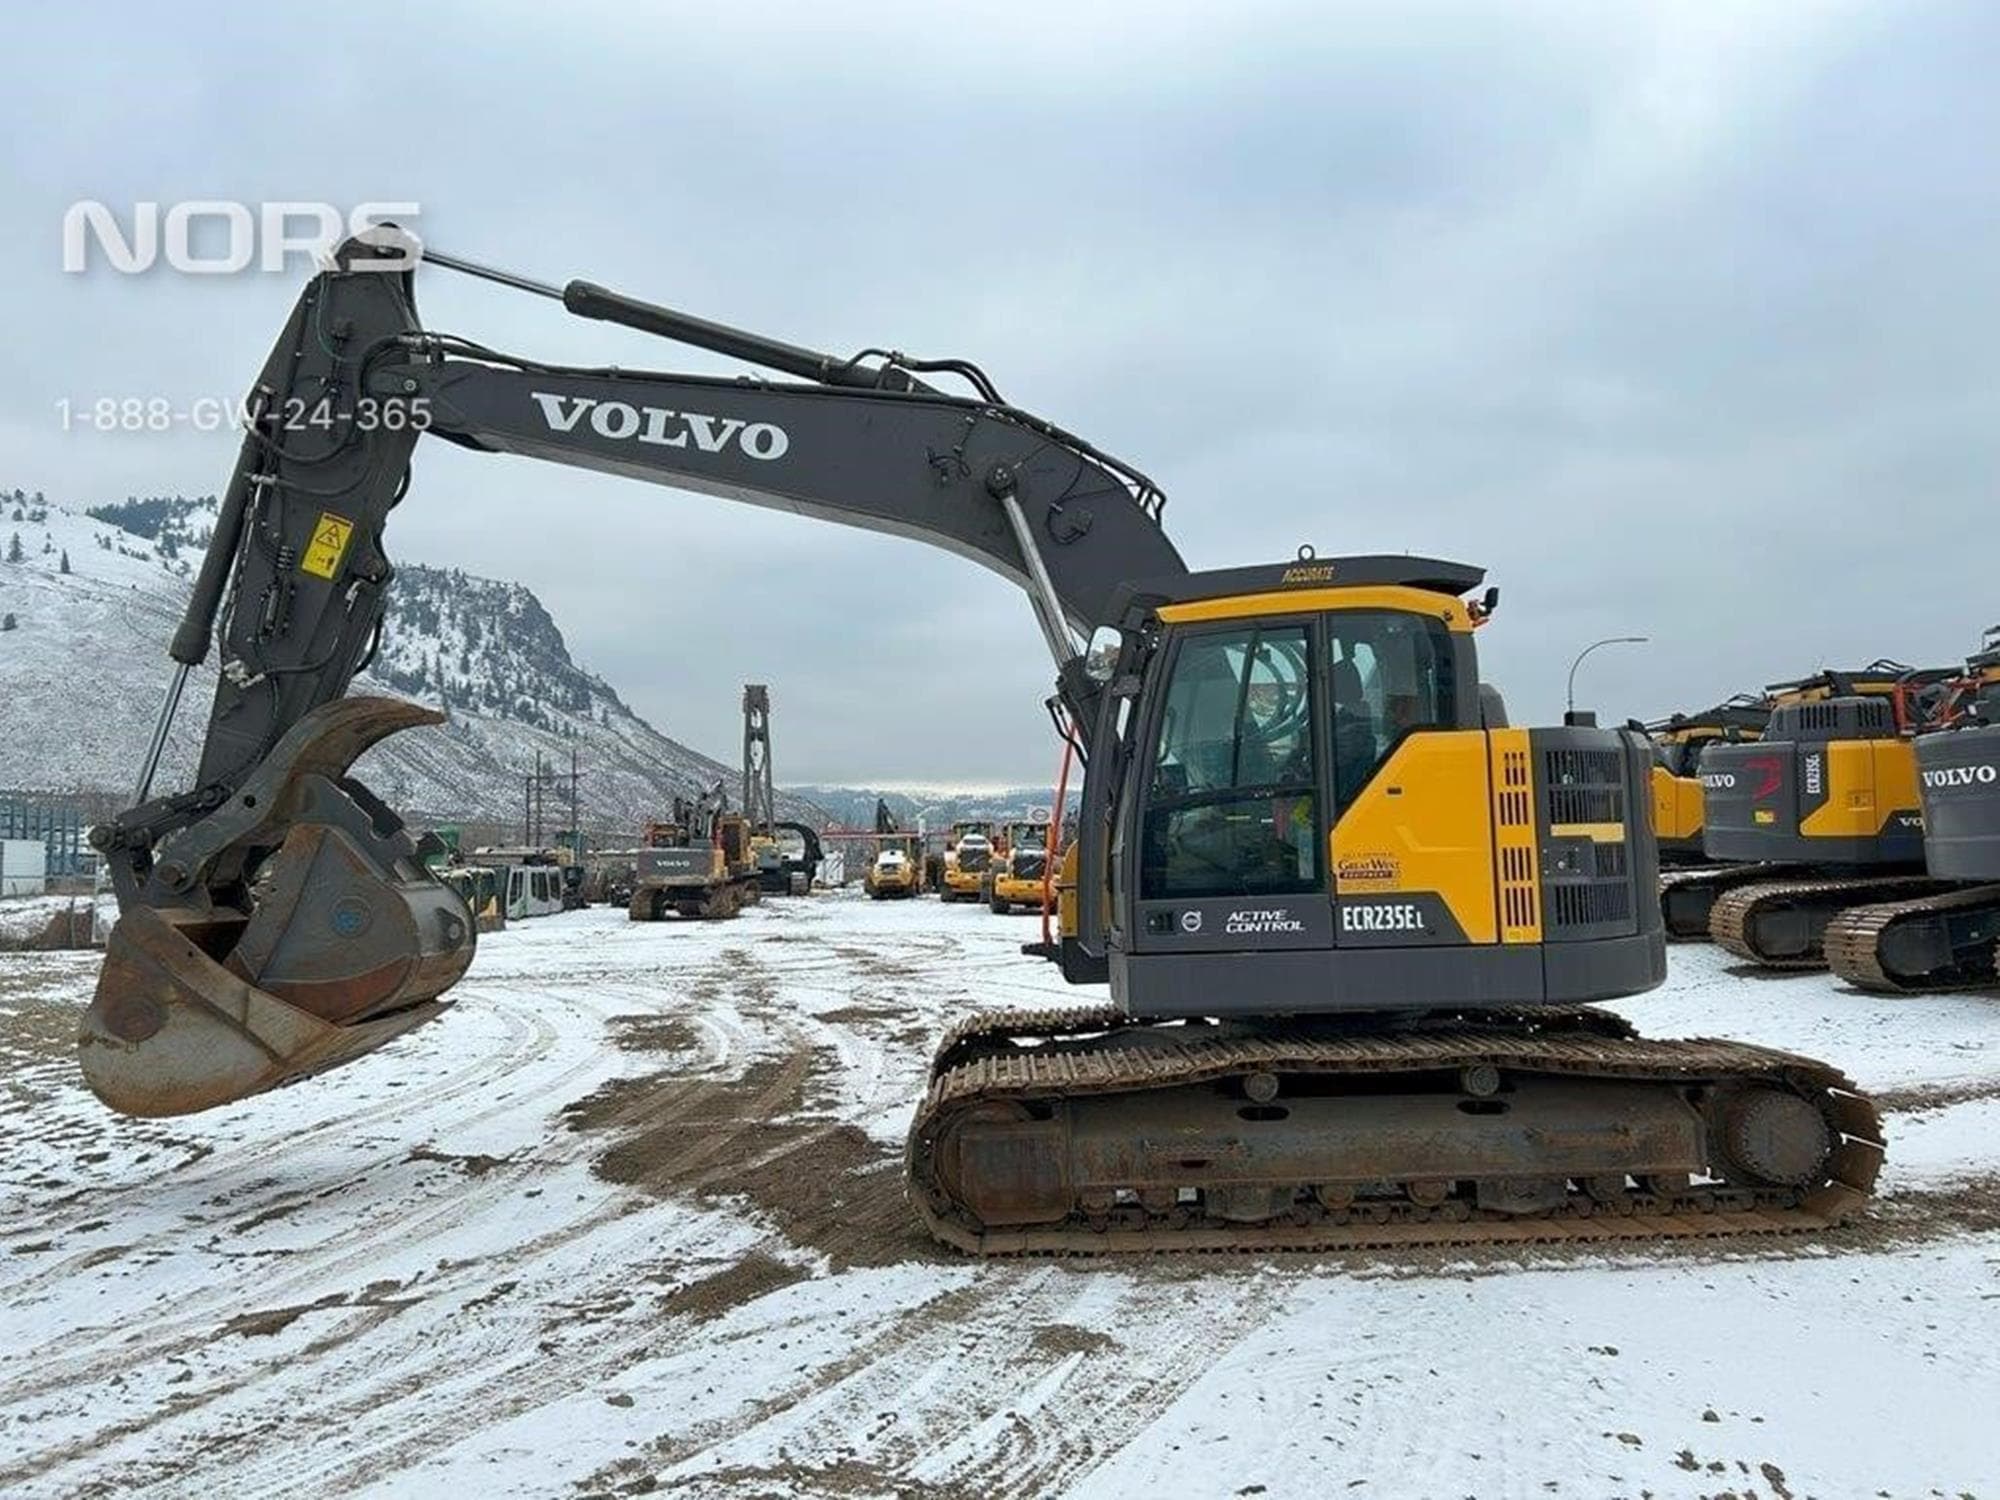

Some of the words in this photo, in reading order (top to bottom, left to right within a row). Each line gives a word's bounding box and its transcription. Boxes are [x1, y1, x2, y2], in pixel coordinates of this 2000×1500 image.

[531, 391, 789, 461] VOLVO
[1922, 765, 1997, 788] VOLVO
[656, 860, 691, 868] VOLVO
[1227, 909, 1288, 922] ACTIVE
[1225, 920, 1306, 934] CONTROL
